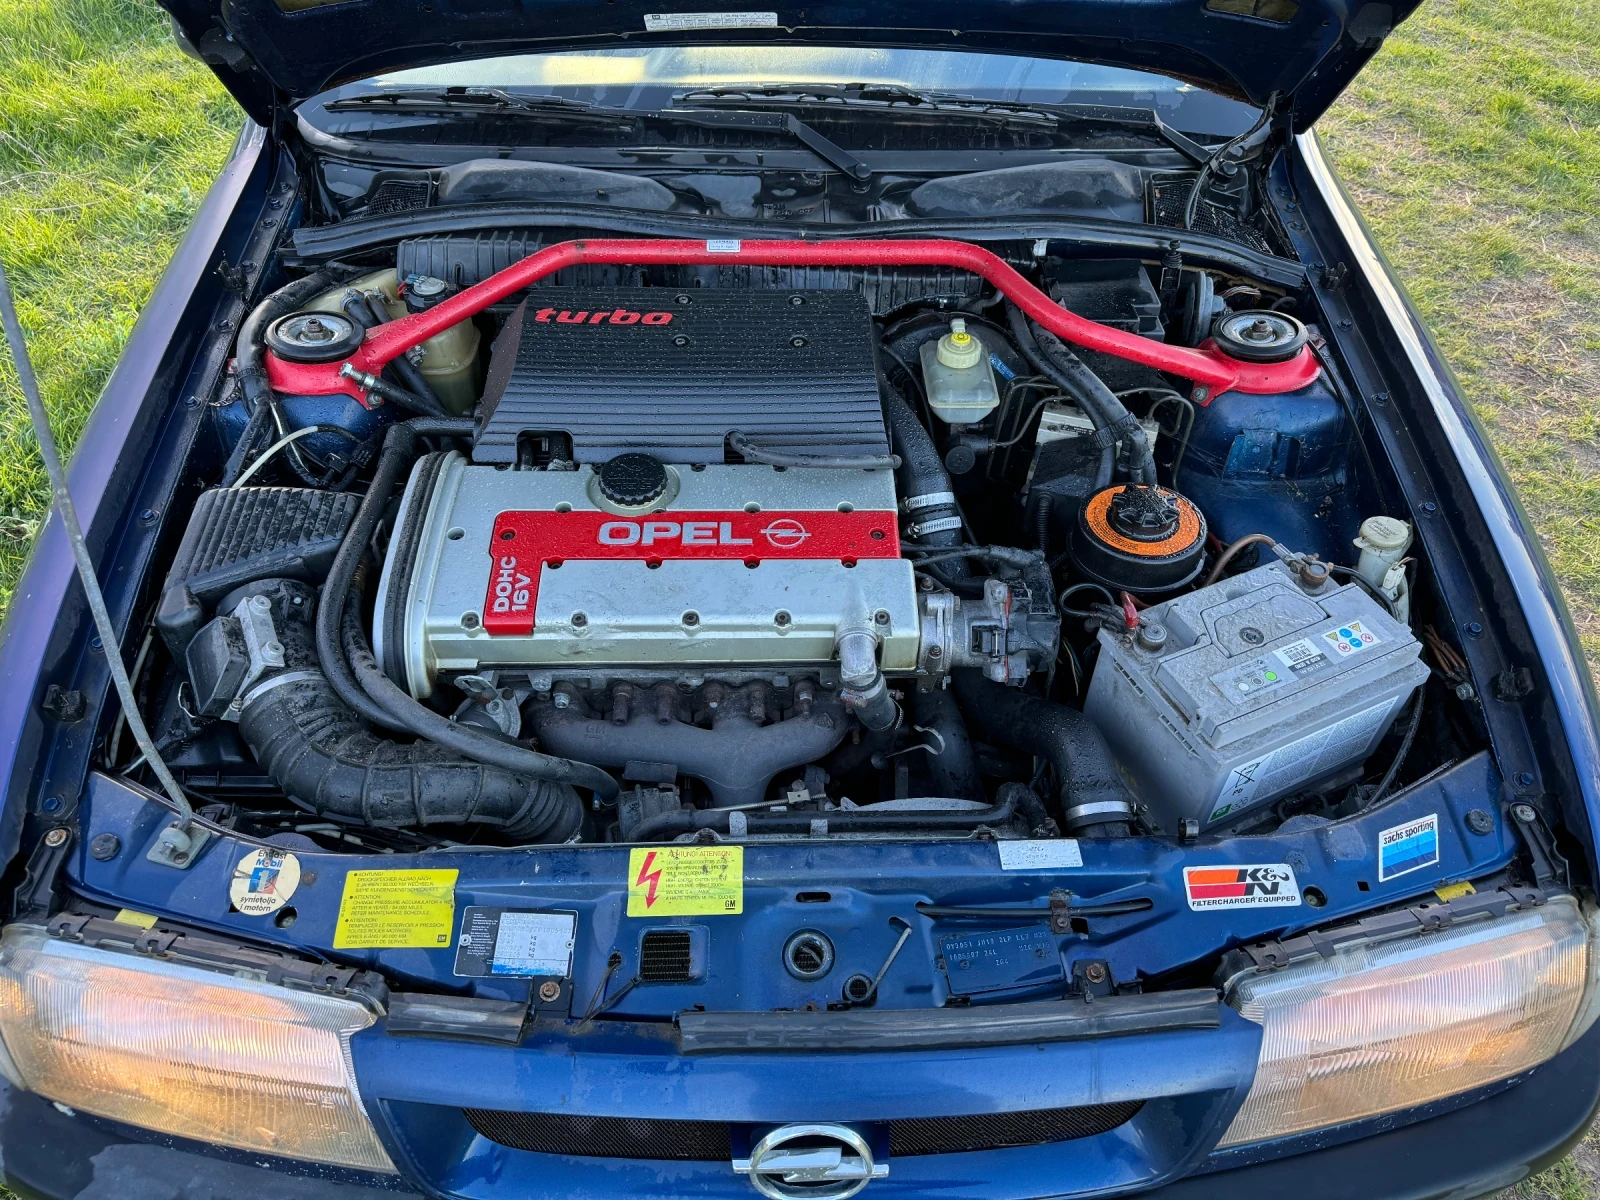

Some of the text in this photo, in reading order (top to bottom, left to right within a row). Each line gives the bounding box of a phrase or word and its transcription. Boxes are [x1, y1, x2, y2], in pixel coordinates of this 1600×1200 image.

[534, 306, 674, 326] turbo
[596, 521, 754, 547] OPEL
[493, 556, 517, 612] DOHC
[511, 573, 531, 611] 16V
[1383, 820, 1434, 845] sachs sporting
[255, 859, 283, 867] Mobil
[240, 896, 276, 905] syntetolja
[724, 900, 736, 908] GM
[1258, 895, 1296, 903] EQUIPPED
